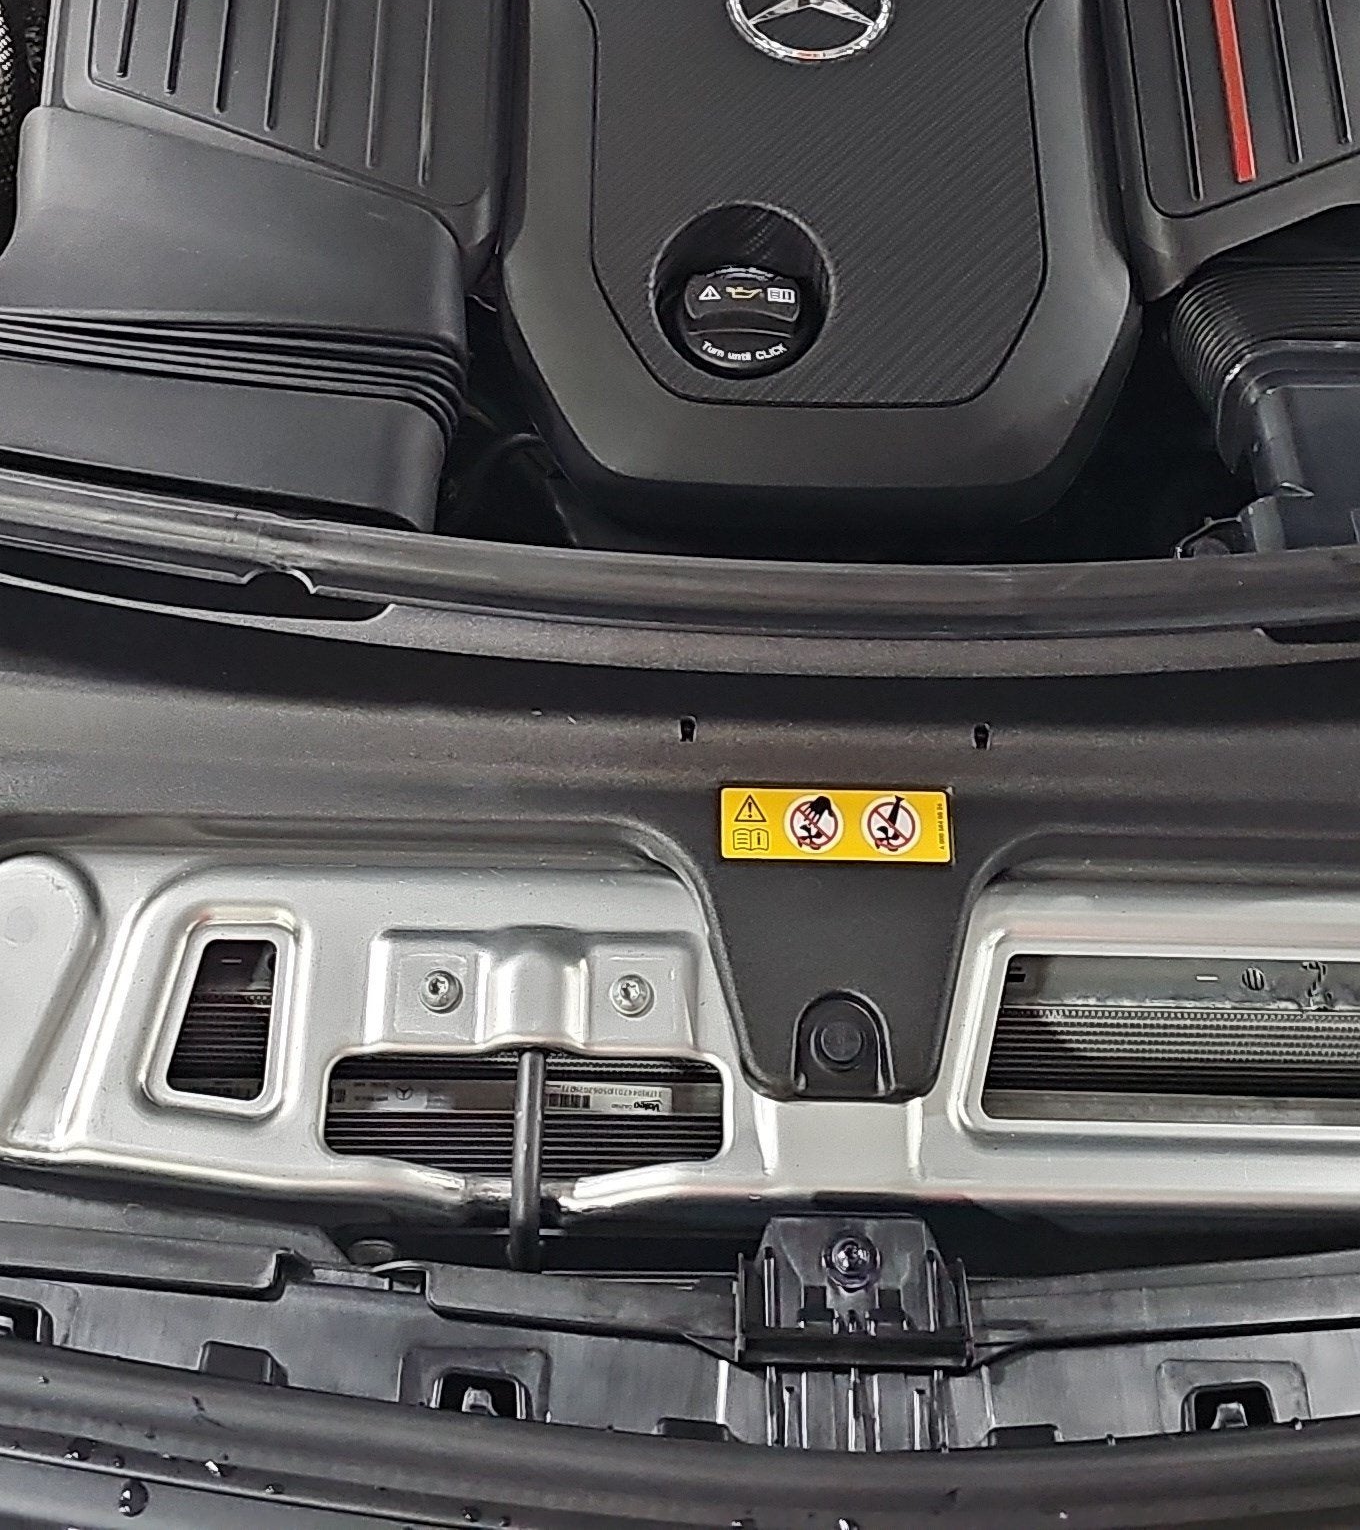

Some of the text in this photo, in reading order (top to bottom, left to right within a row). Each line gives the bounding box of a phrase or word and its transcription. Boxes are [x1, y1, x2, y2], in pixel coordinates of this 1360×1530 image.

[702, 341, 788, 361] Turn until CLICK
[633, 1101, 661, 1111] Valeo
